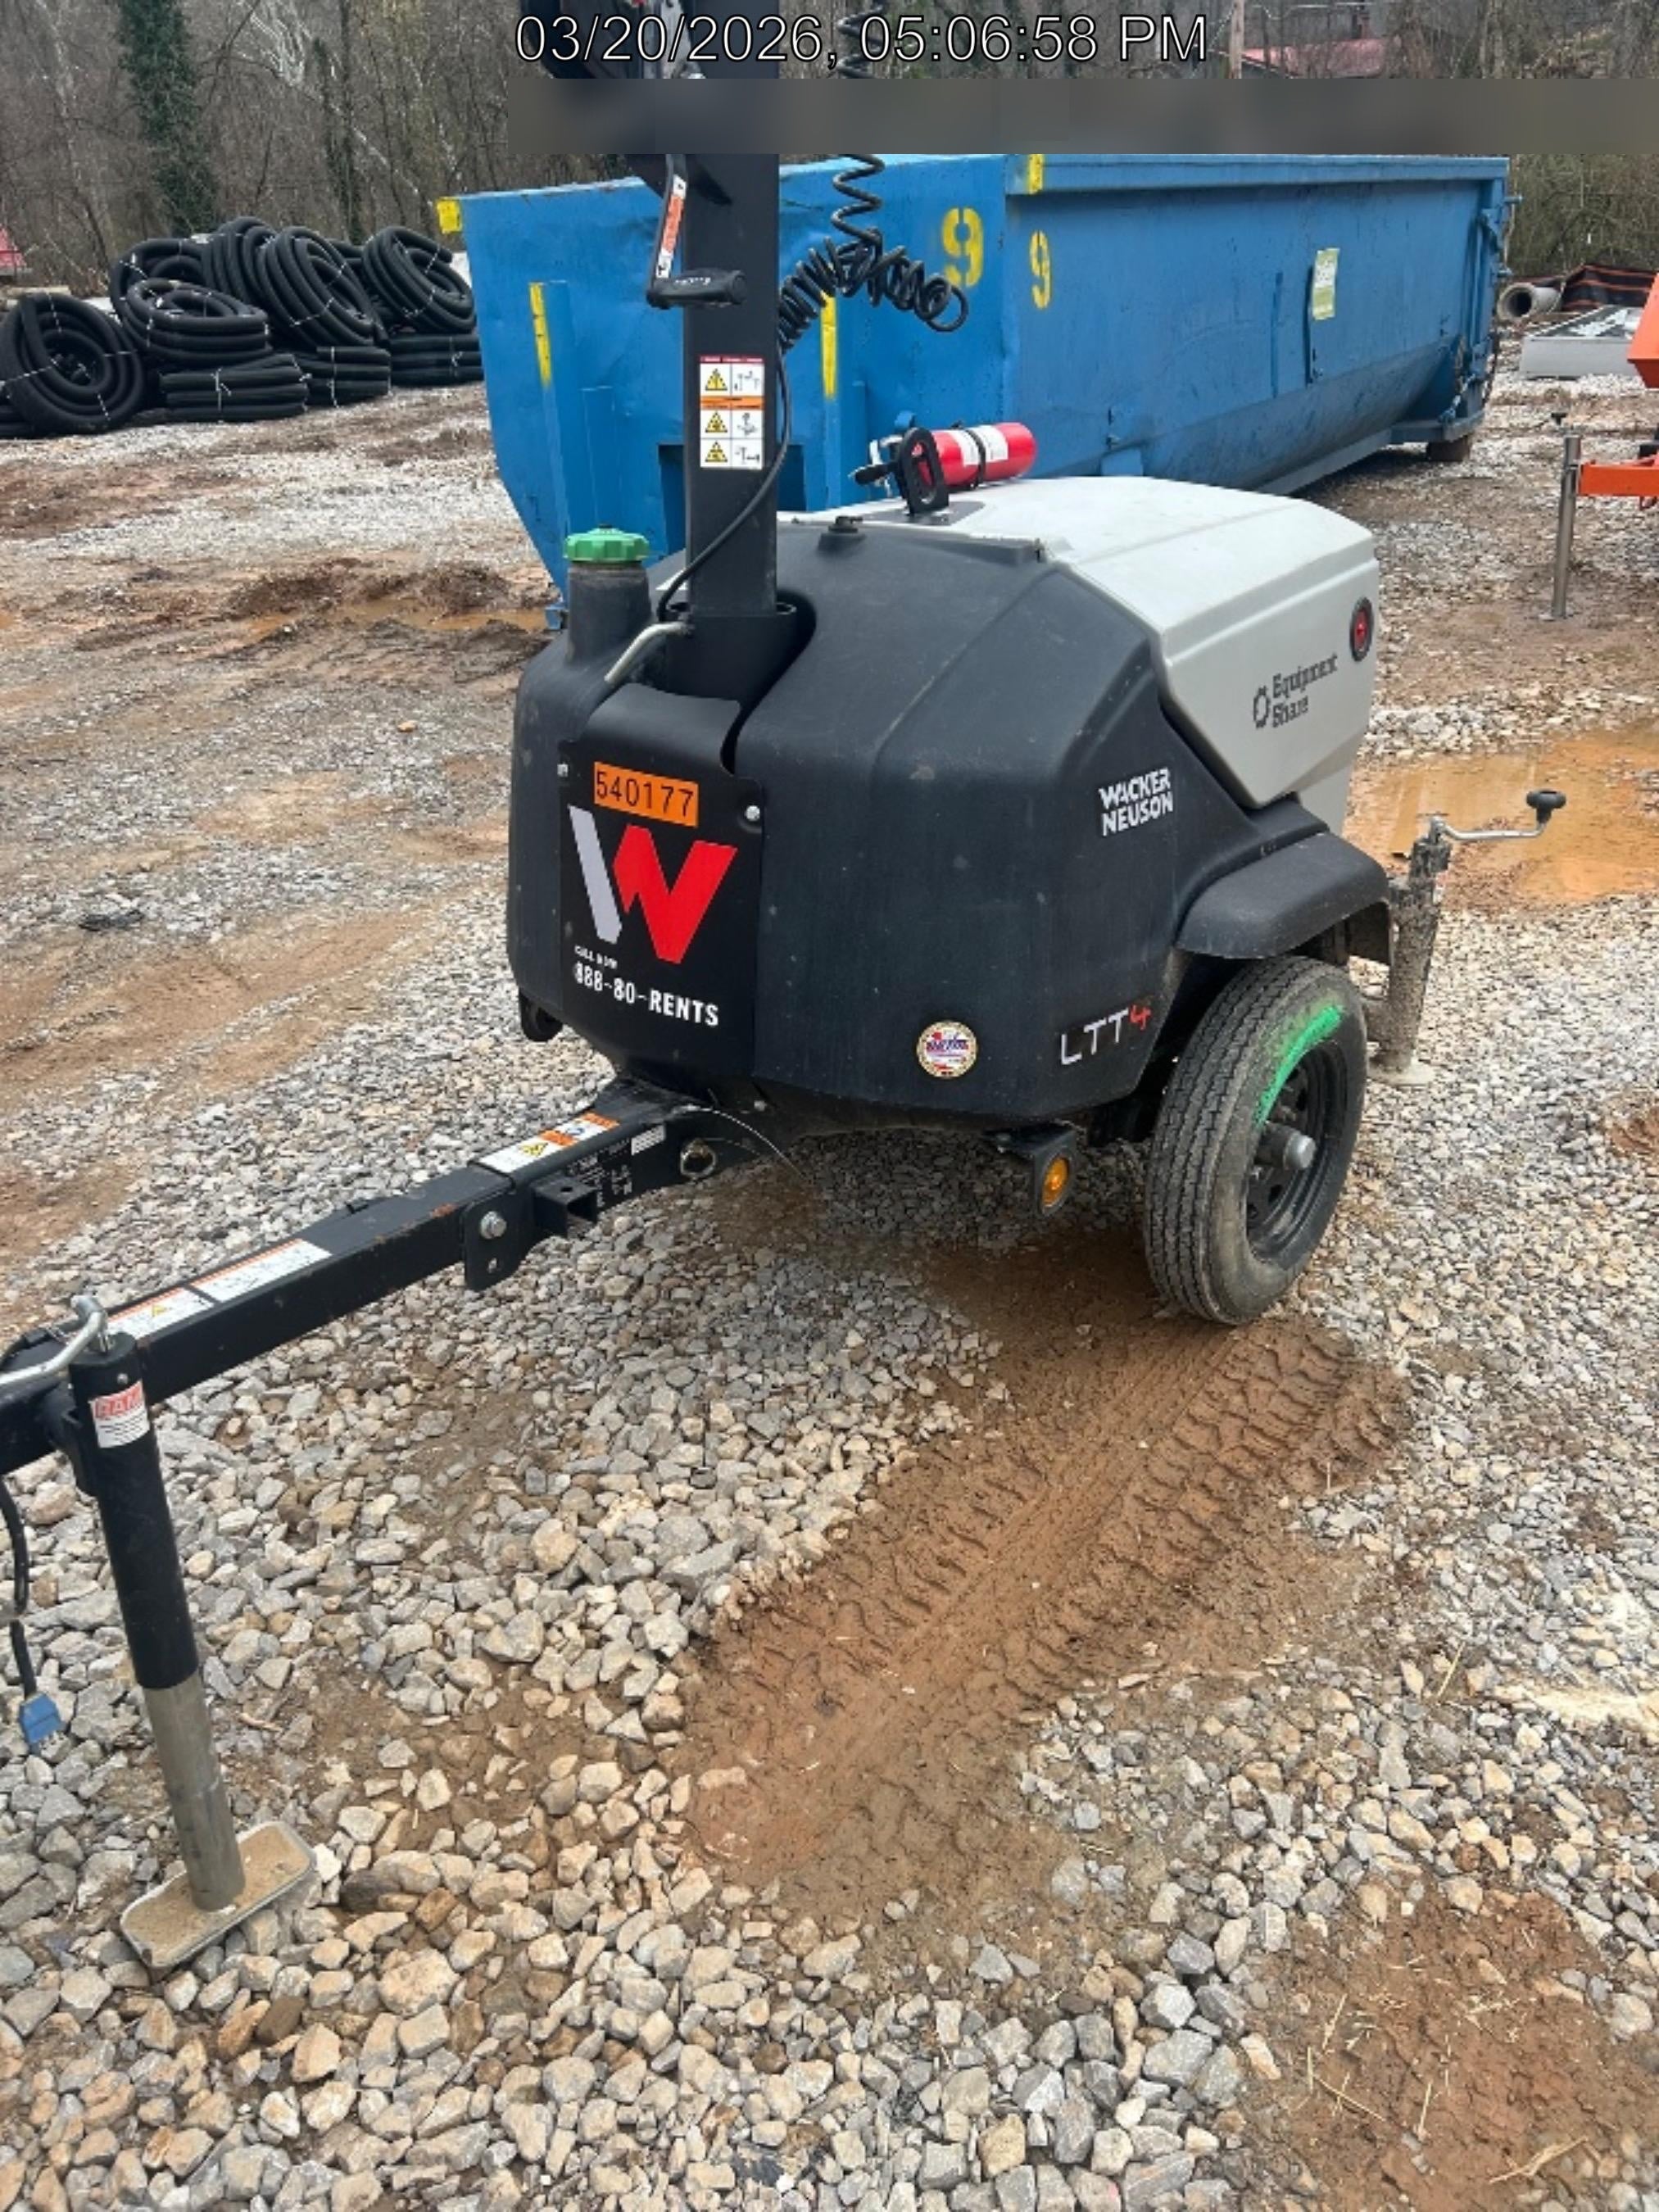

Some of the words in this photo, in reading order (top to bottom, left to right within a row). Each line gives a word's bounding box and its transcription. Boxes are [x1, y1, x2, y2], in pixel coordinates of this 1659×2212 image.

[943, 207, 983, 287] 9
[1030, 230, 1051, 310] 9
[596, 772, 694, 817] 540177
[1099, 767, 1170, 809] WACKER
[1102, 791, 1173, 836] NEUSON
[1061, 1004, 1151, 1065] LTT4
